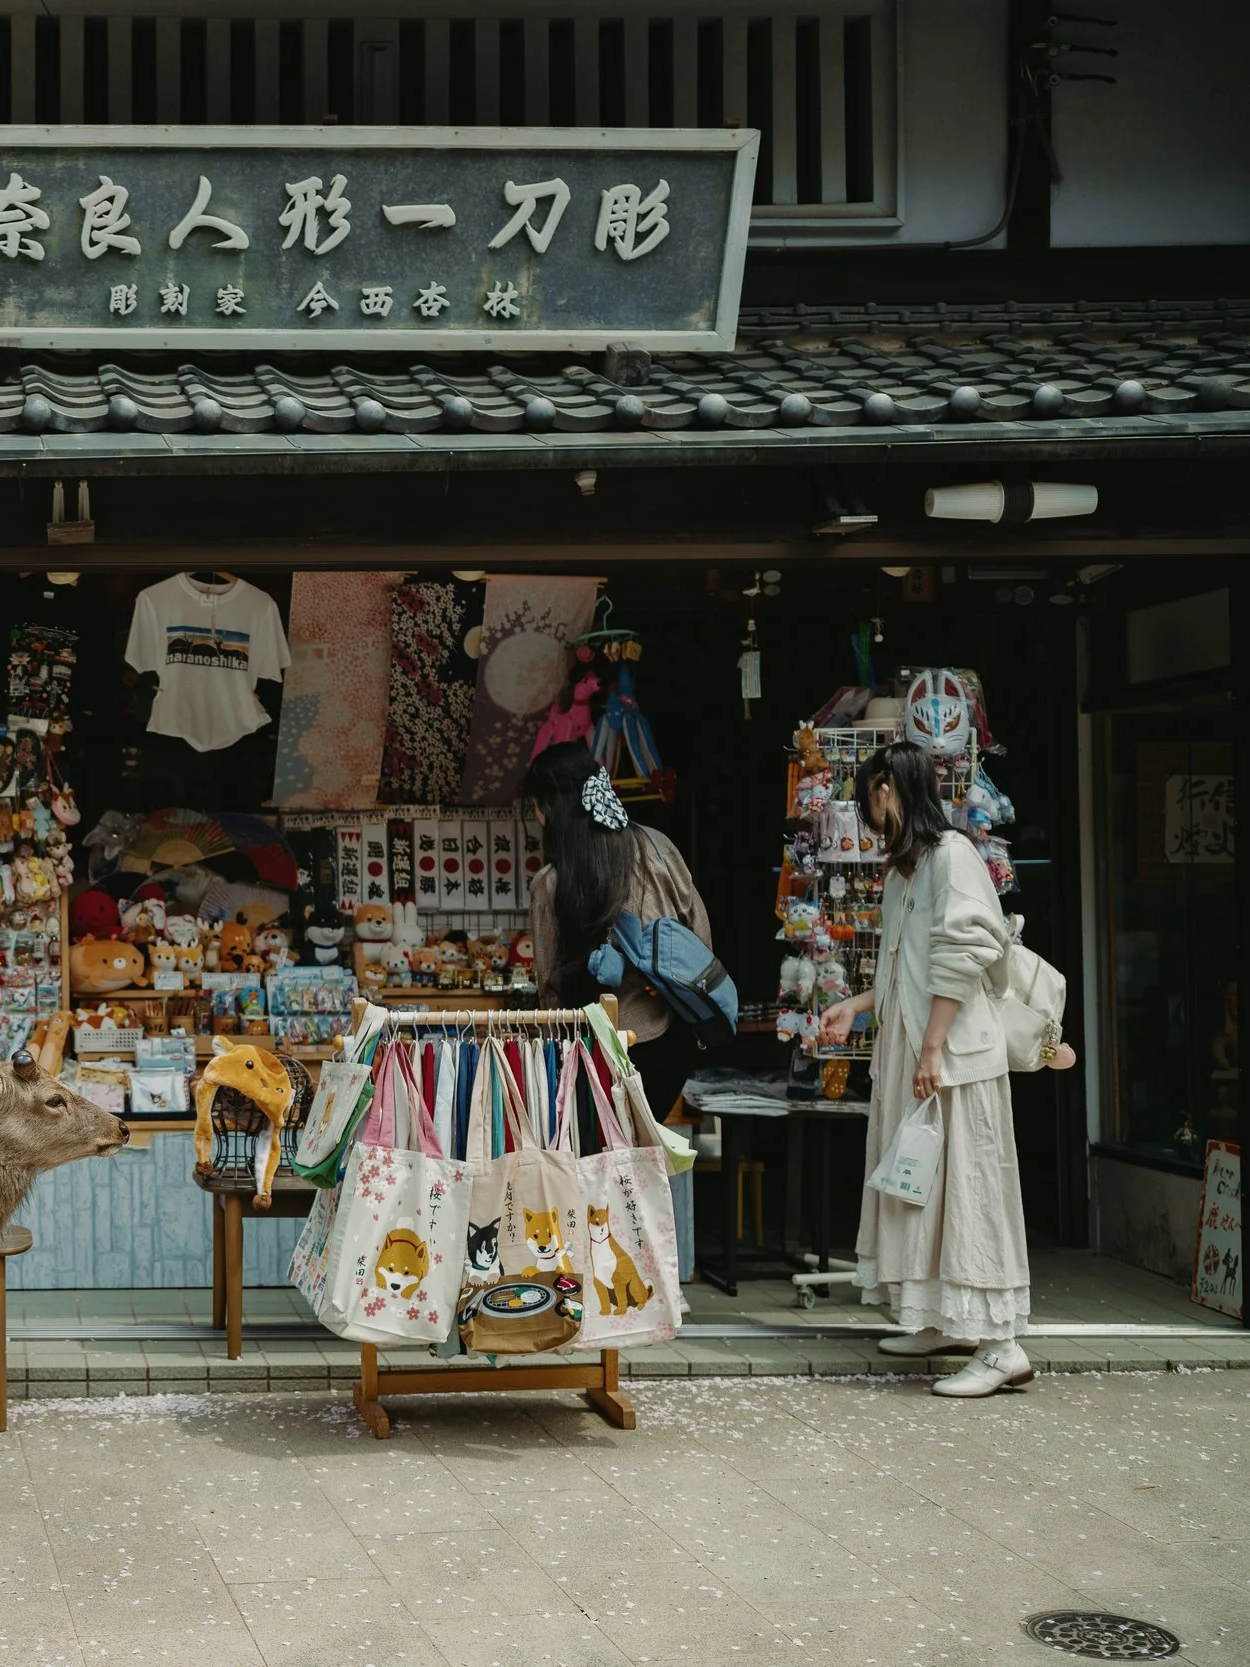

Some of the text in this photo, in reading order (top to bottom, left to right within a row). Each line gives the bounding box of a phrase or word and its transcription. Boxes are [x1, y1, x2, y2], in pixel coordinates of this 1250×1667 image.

[109, 280, 522, 319] 彫刻家 今西杏林
[166, 653, 248, 671] naranoshika
[341, 845, 359, 896] 新選組
[392, 837, 411, 890] 新選組
[442, 837, 461, 896] 日本
[466, 835, 485, 898] 合格
[494, 834, 512, 895] 根性
[619, 1174, 645, 1250] 桜が好きです
